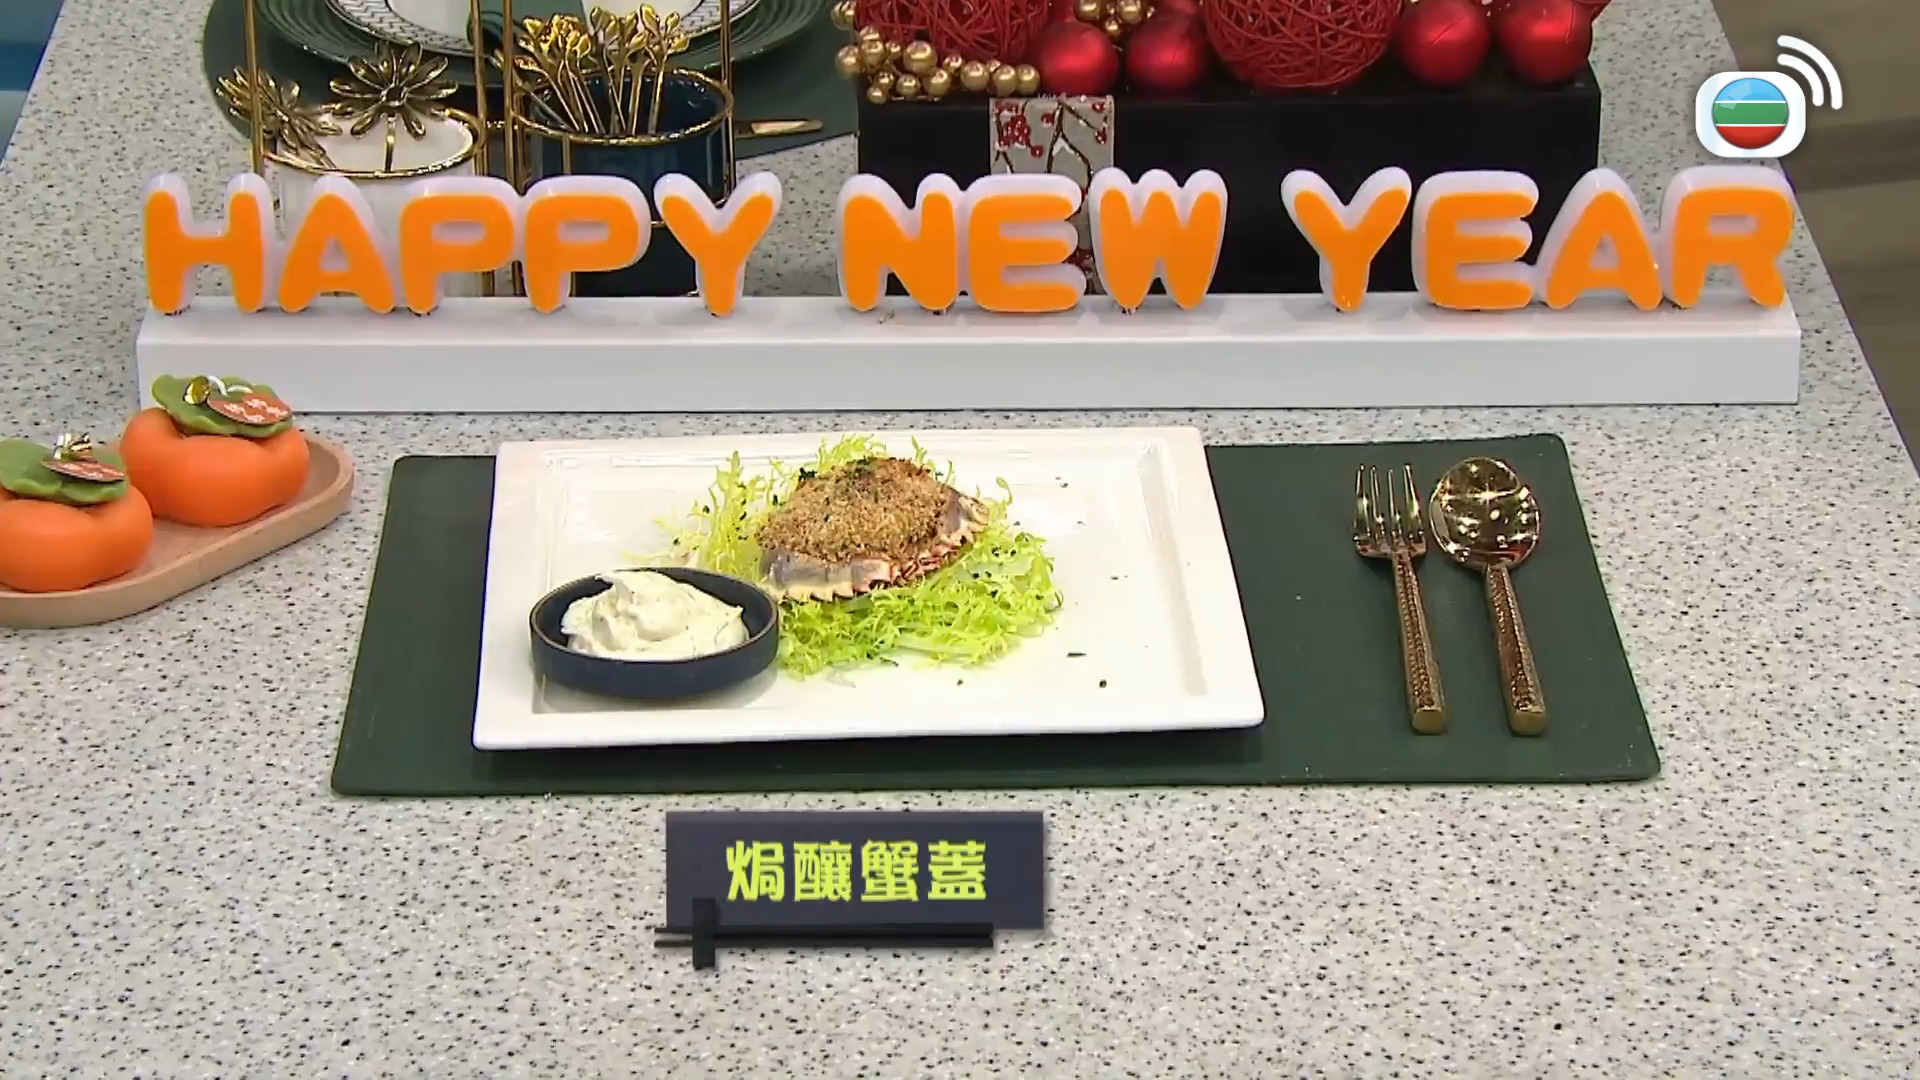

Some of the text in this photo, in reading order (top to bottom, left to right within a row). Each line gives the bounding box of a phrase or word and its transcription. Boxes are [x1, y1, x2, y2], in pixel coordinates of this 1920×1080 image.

[143, 165, 1795, 315] HAPPY NEW YEAR
